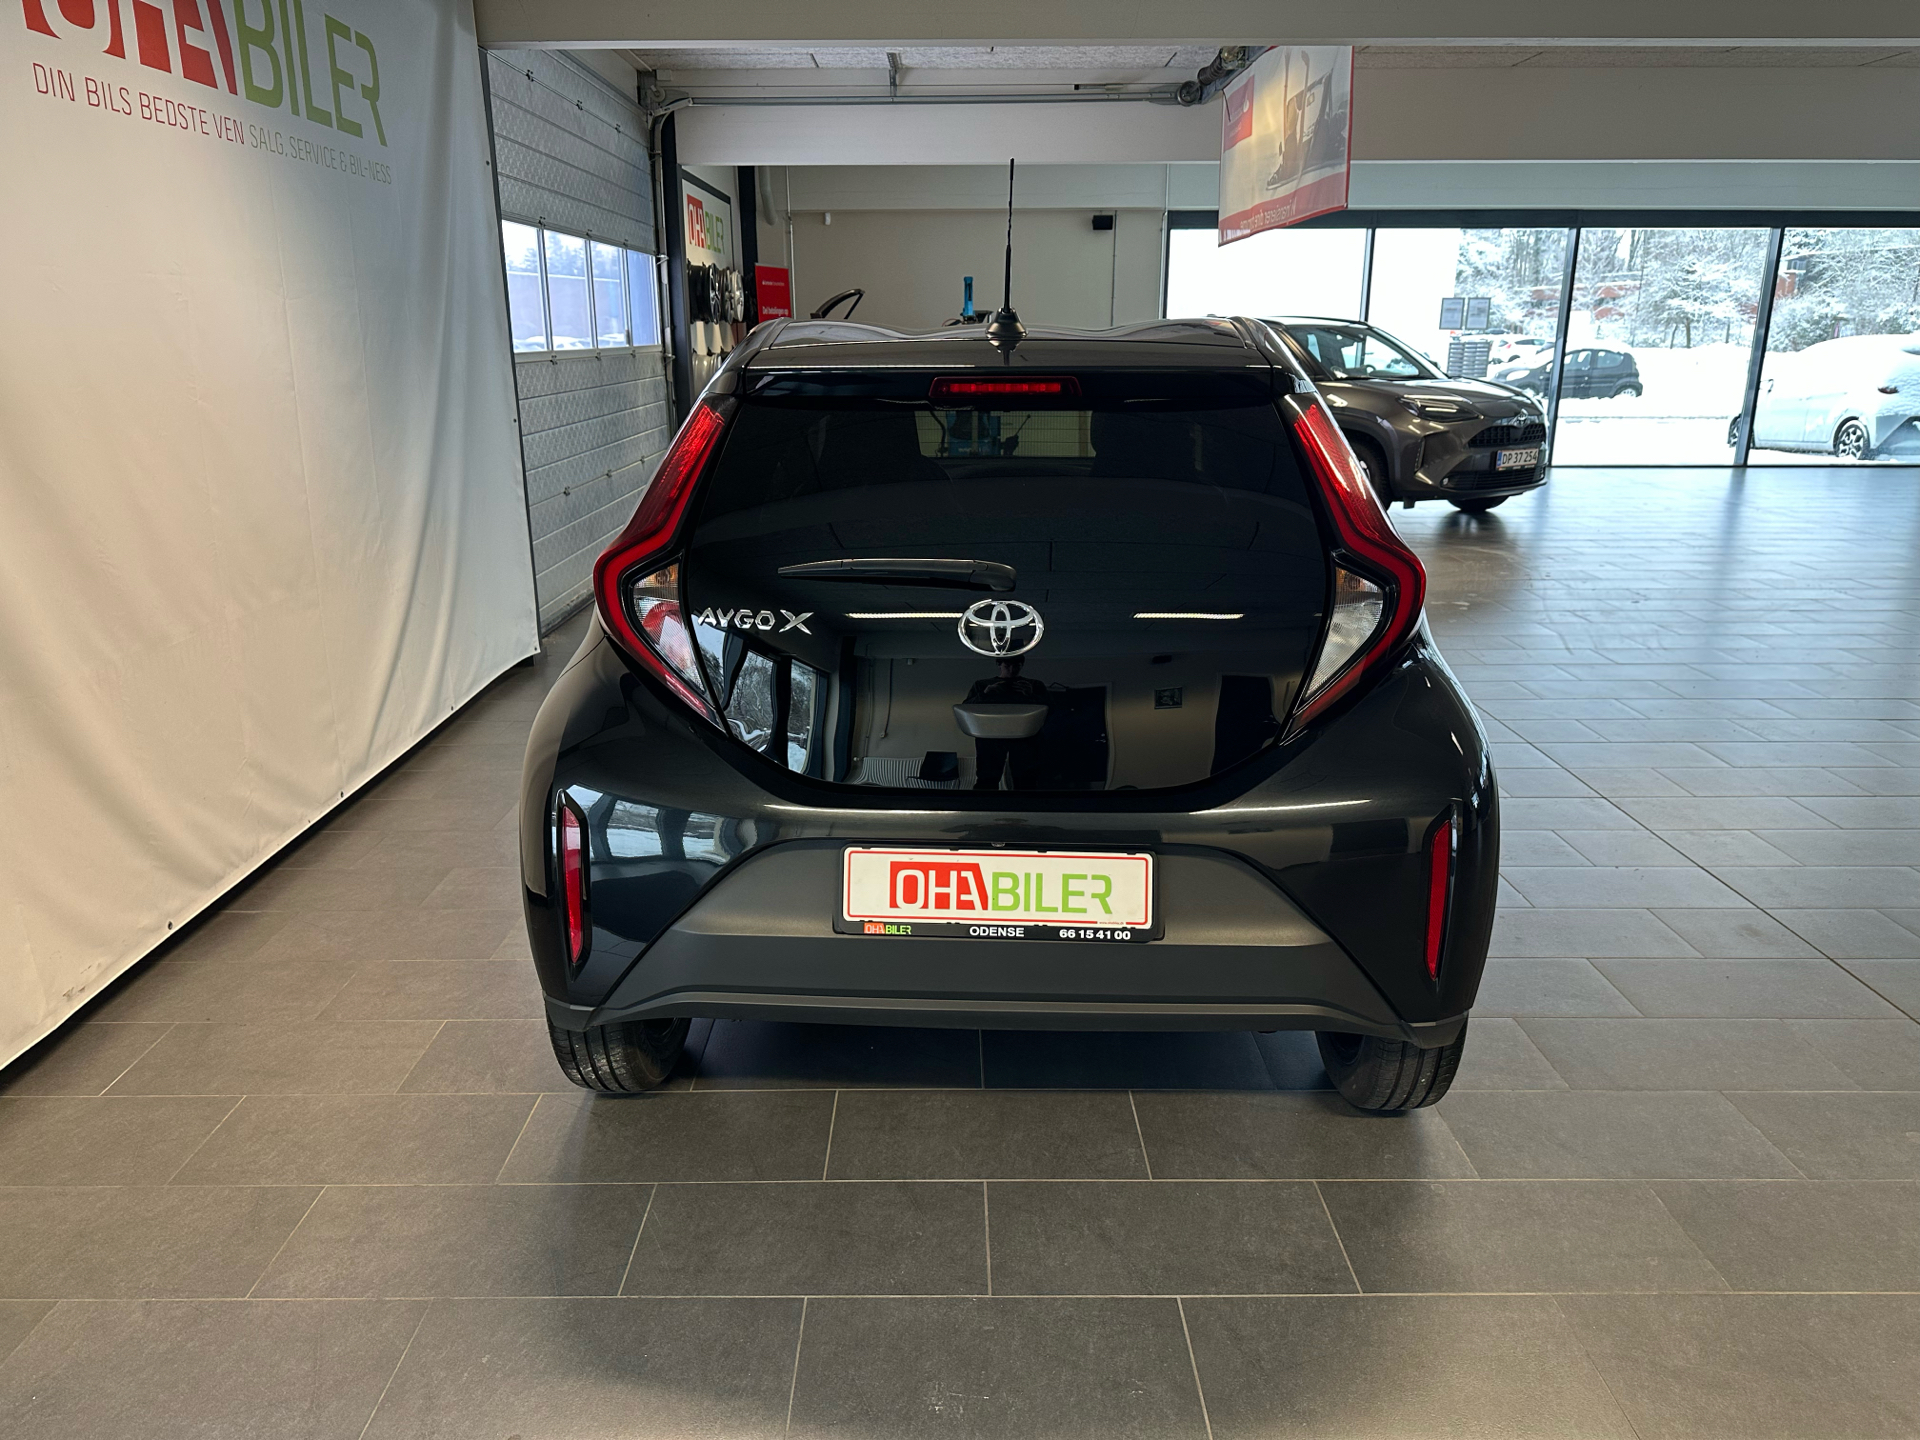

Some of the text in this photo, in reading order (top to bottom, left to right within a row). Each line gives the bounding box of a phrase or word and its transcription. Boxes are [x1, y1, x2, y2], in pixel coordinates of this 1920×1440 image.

[33, 62, 75, 102] DIN
[85, 76, 132, 116] BILS
[139, 92, 210, 136] BEDSTE
[212, 113, 245, 145] VEN
[289, 136, 338, 171] SERVICE
[339, 152, 347, 172] &
[349, 155, 392, 185] BIL-NESS
[1502, 450, 1538, 465] DP 37 254
[697, 607, 815, 636] AYGO X
[969, 925, 1131, 940] ODENSE 66 15 41 00
